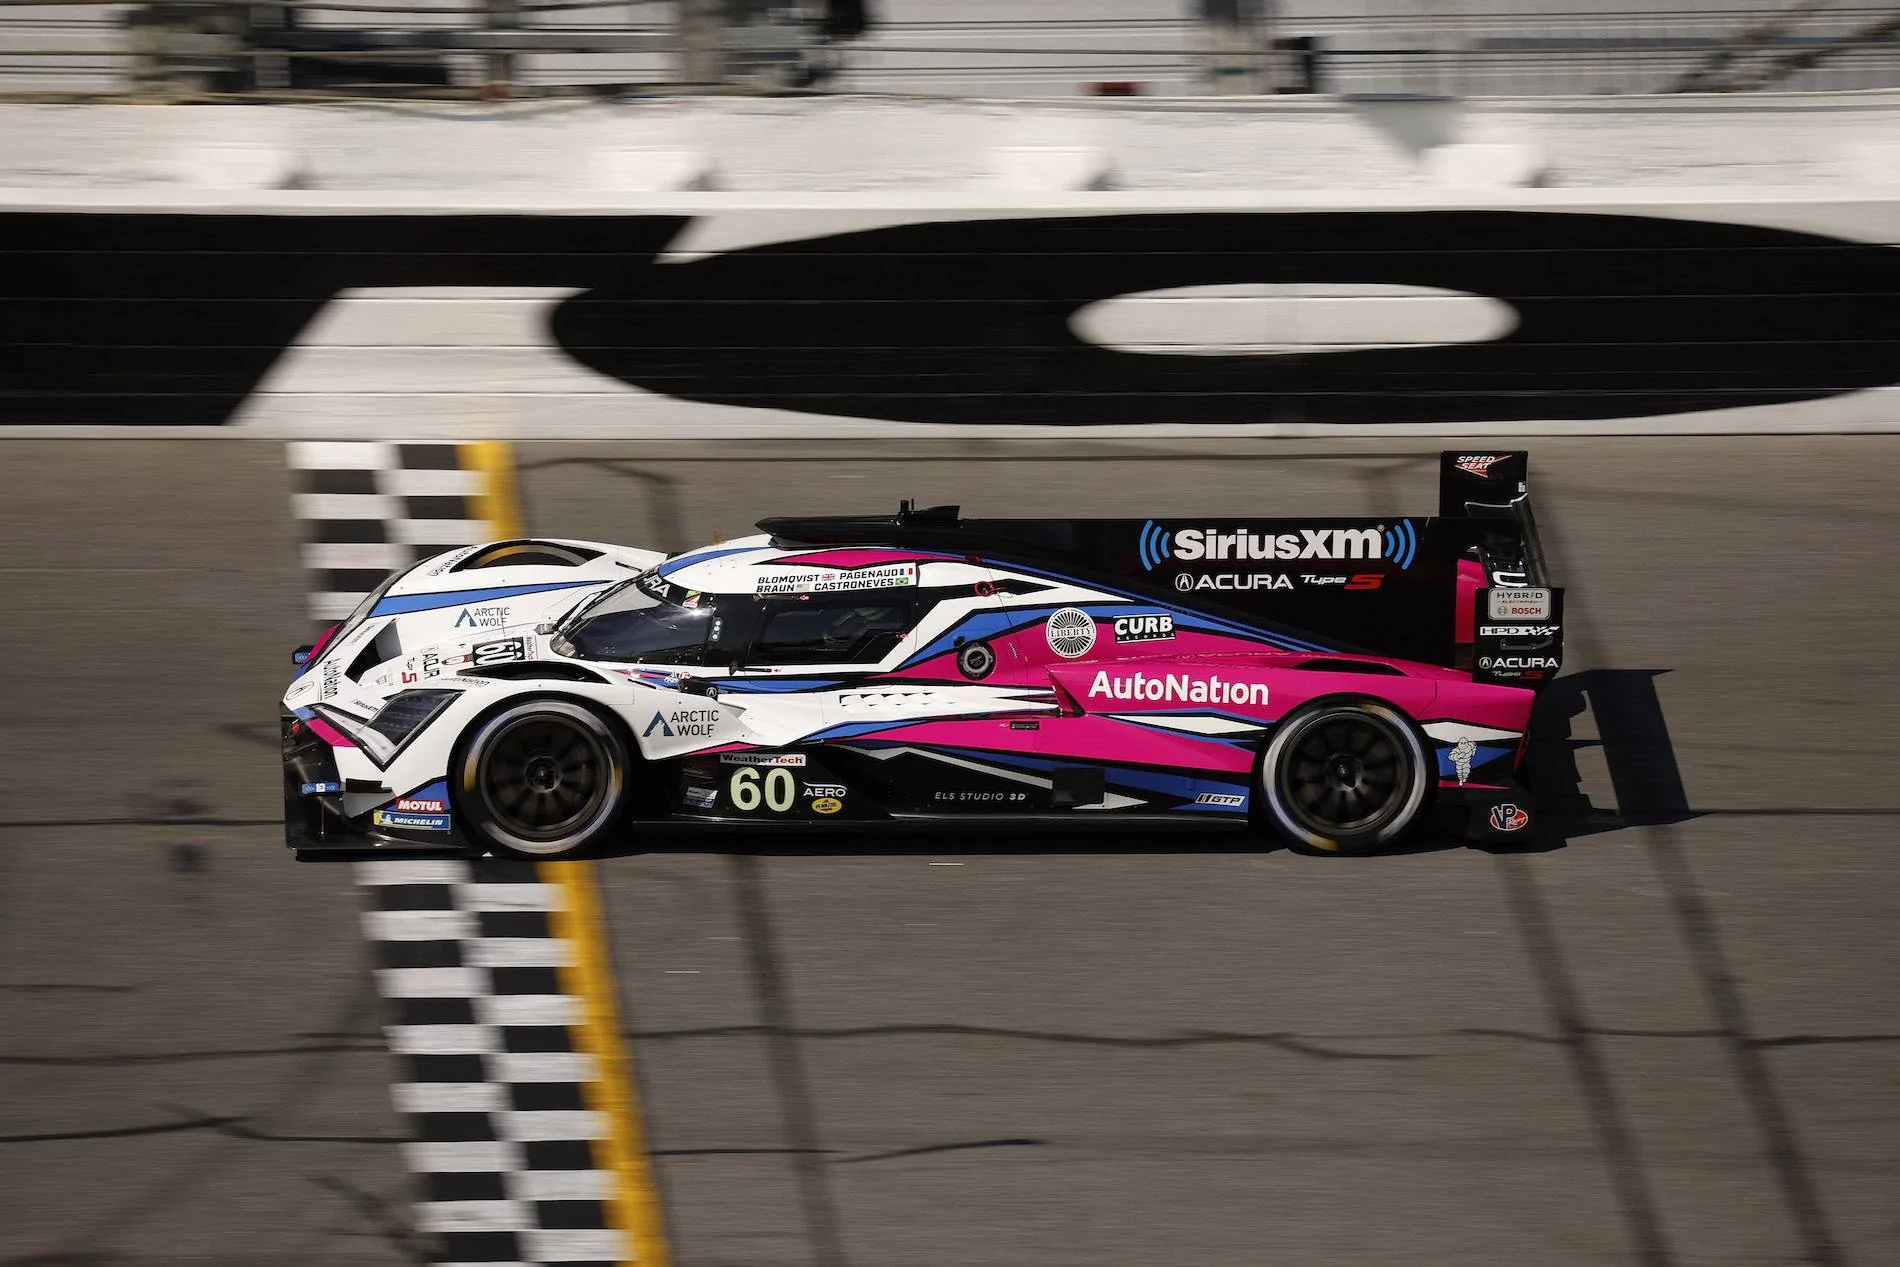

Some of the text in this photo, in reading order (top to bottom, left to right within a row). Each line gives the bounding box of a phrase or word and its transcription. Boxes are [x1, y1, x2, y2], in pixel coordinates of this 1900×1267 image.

[758, 569, 898, 584] BLOMQVIST PAGENAUD
[1195, 574, 1385, 590] ACURA Type S
[756, 578, 894, 593] BRAUN CASTRONEVES
[474, 607, 510, 617] ARCTIC
[1512, 607, 1542, 615] BOSCH
[479, 617, 507, 627] WOLF
[1114, 616, 1173, 636] CURB
[1051, 627, 1092, 638] LIBERTY
[1482, 627, 1520, 635] HPD
[1492, 657, 1559, 668] ACURA
[1088, 671, 1269, 705] AutoNation
[670, 709, 720, 723] ARCTIC
[677, 724, 715, 736] WOLF
[722, 754, 804, 764] WeatherTech
[730, 766, 796, 813] 60
[803, 787, 847, 797] AERO
[934, 792, 1026, 801] ELS STUDIO 3D
[1210, 796, 1243, 804] GTP
[398, 800, 443, 811] MOTUL
